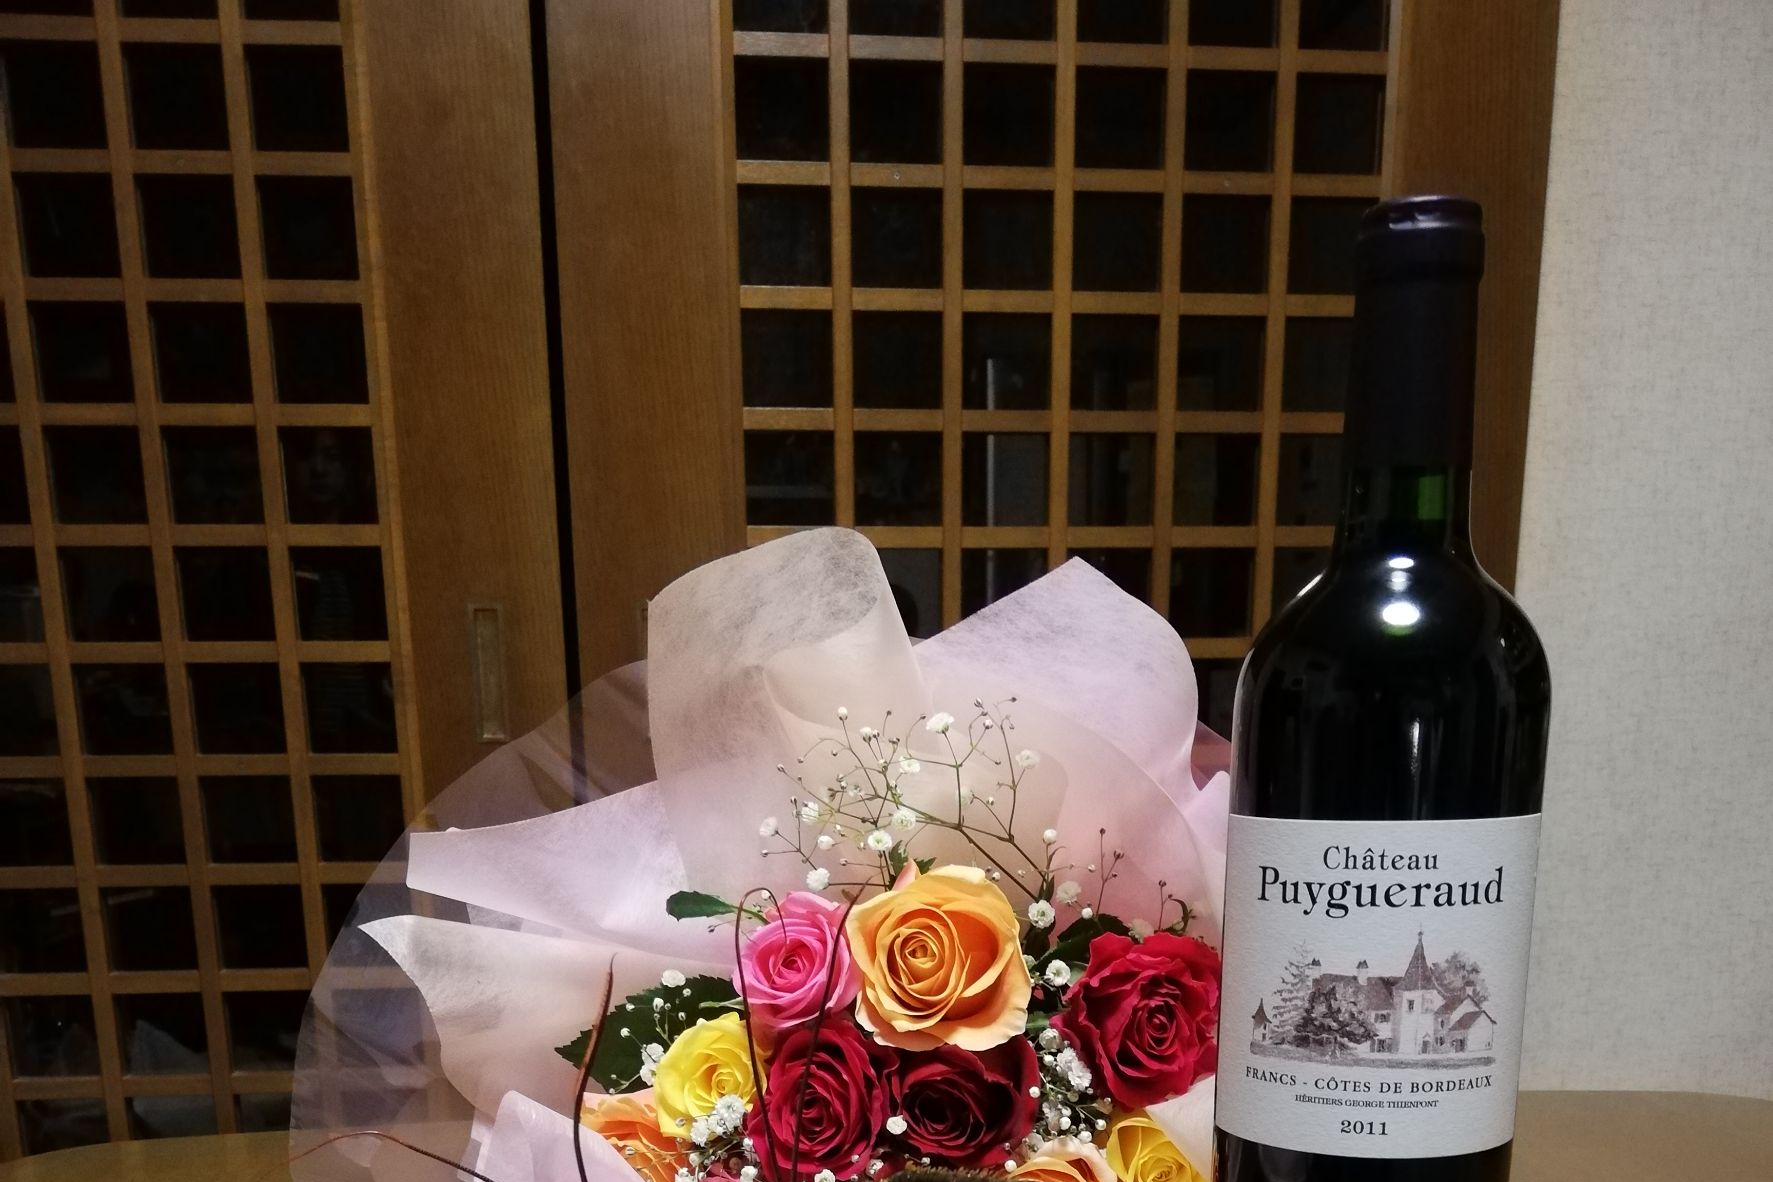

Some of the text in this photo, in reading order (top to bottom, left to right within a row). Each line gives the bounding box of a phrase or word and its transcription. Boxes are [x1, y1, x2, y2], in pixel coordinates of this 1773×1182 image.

[1323, 845, 1440, 870] Château
[1257, 865, 1504, 918] Puygueraud
[1245, 1065, 1297, 1087] FRANCS
[1314, 1076, 1371, 1093] CÔTES
[1379, 1081, 1403, 1094] DE
[1409, 1074, 1492, 1094] BORDEAUX
[1295, 1093, 1439, 1109] HÉRITIERS GEORGE THIENPONT
[1340, 1119, 1389, 1136] 2011
